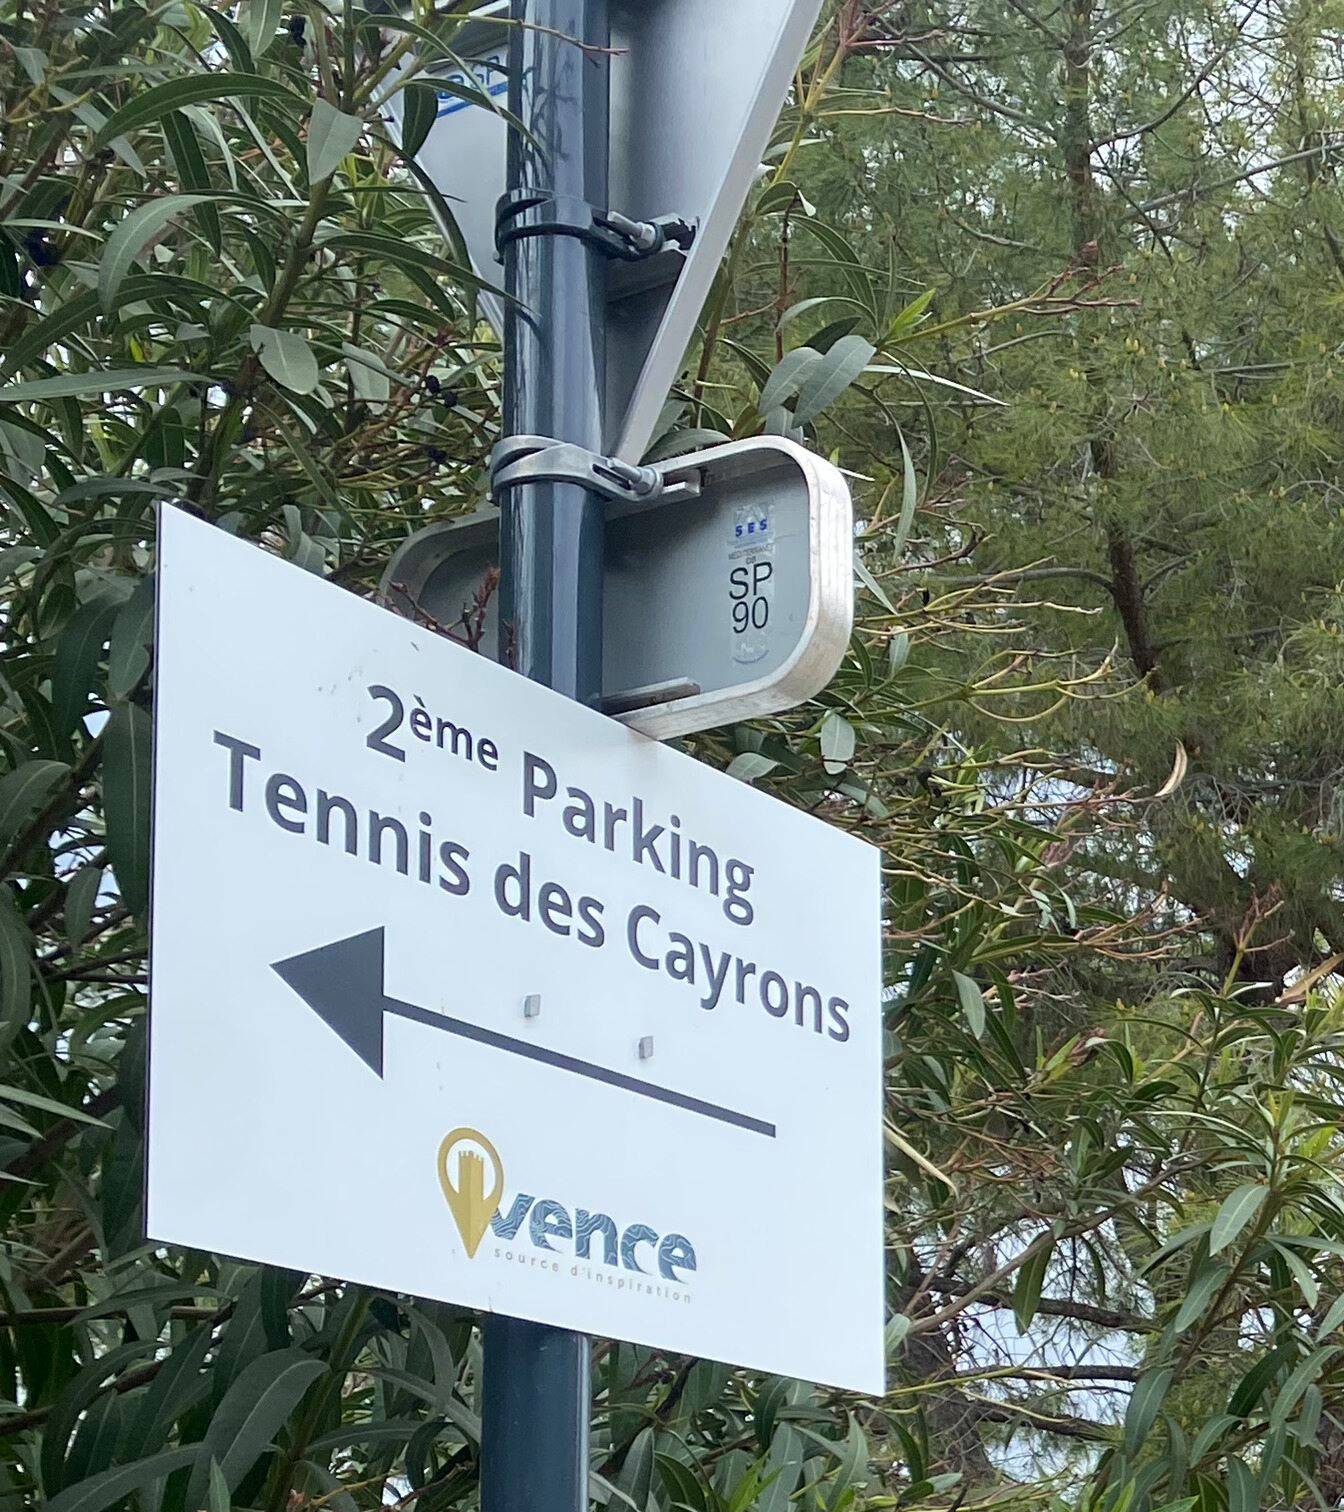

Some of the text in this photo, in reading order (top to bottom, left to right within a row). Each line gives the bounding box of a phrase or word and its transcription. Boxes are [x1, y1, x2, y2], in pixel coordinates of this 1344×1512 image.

[729, 561, 773, 600] SP
[732, 596, 769, 634] 90
[366, 684, 755, 926] 2ème Parking
[213, 730, 850, 1043] Tennis des Cayrons
[490, 1193, 697, 1285] vence
[494, 1248, 692, 1304] source d'inspiration
